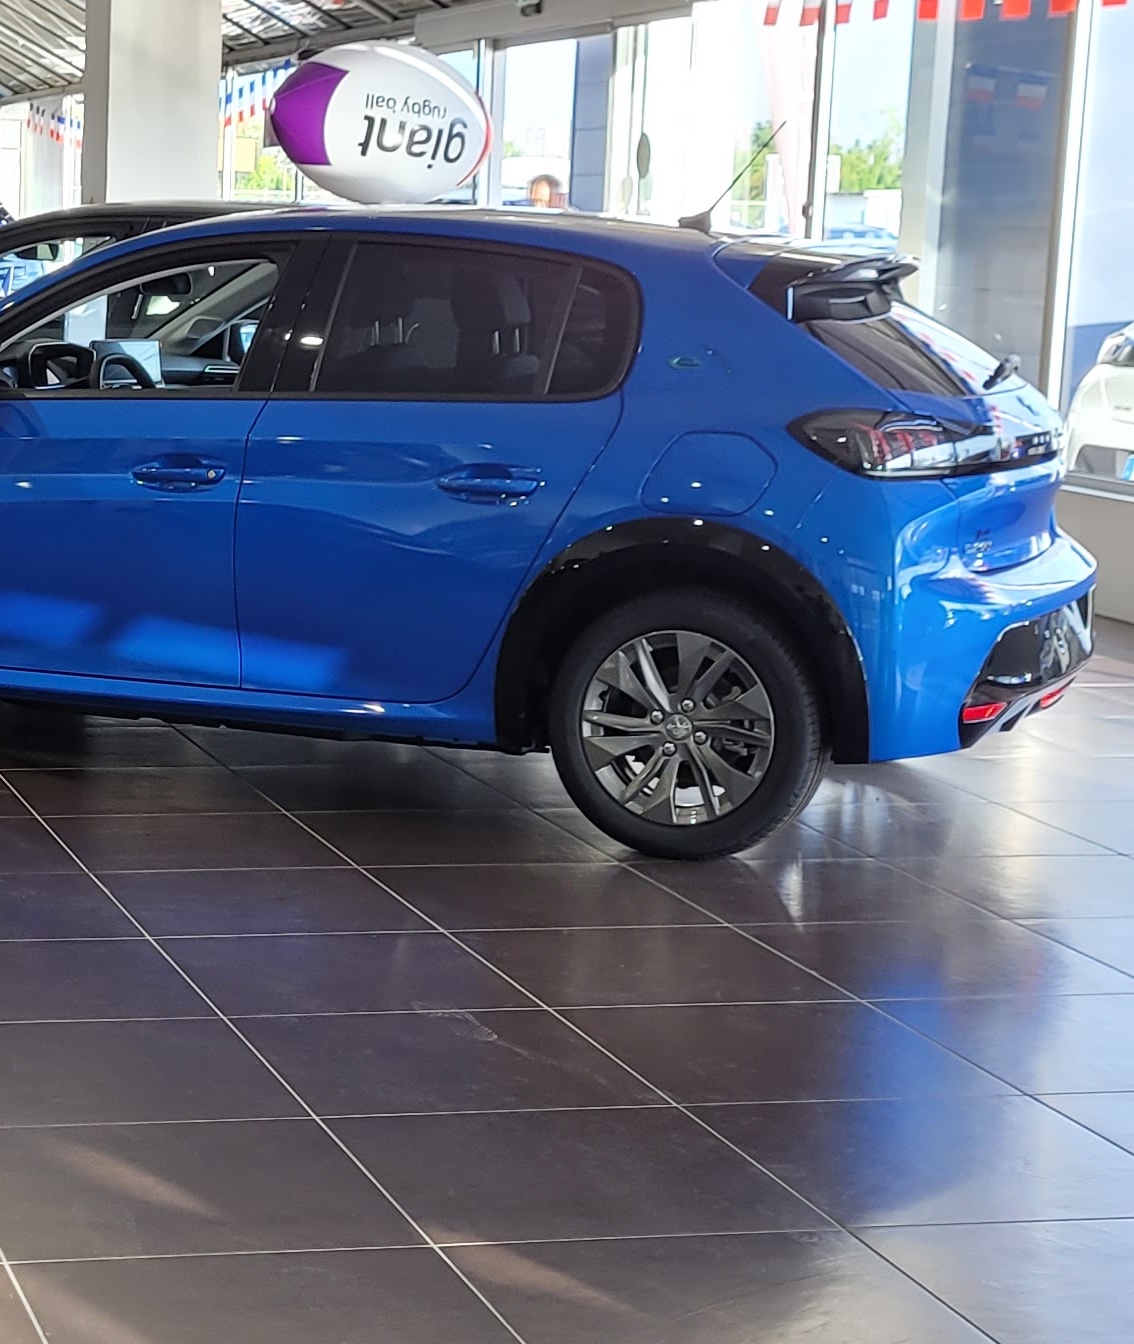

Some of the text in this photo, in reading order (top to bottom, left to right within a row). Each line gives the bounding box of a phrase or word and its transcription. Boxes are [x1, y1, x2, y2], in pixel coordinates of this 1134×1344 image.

[365, 93, 447, 119] rugby ball
[358, 114, 468, 169] giant
